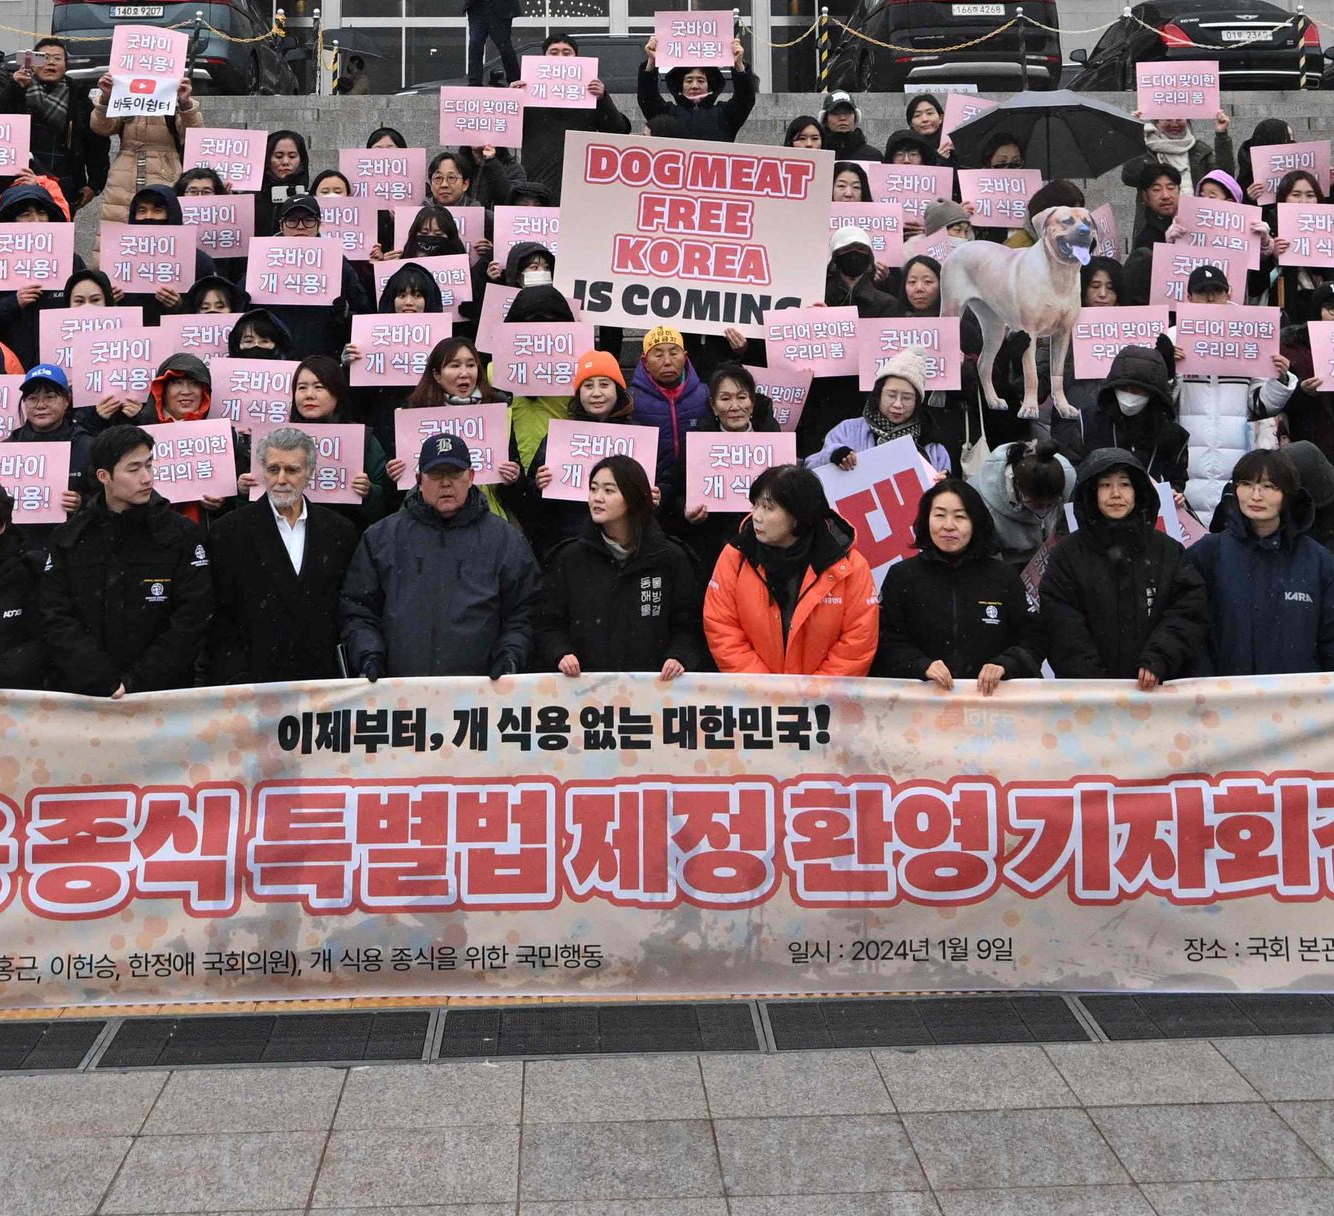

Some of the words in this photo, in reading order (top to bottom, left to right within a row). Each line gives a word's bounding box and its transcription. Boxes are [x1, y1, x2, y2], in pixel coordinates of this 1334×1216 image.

[140, 7, 162, 15] 9207
[979, 6, 1001, 14] 4268
[671, 20, 717, 36] 굿바이
[127, 34, 171, 52] 굿바이
[667, 42, 682, 58] 개
[687, 41, 722, 58] 식용!
[120, 55, 134, 71] 개
[139, 54, 174, 72] 식용!
[537, 65, 582, 81] 굿바이
[533, 84, 547, 99] 개
[552, 83, 585, 99] 식용!
[1141, 75, 1176, 88] 드디어
[1179, 74, 1214, 88] 맞이한
[113, 96, 170, 112] 바둑이쉼터
[444, 99, 480, 114] 드디어
[483, 100, 519, 115] 맞이한
[1153, 90, 1189, 105] 우리의
[1192, 90, 1203, 104] 봄
[455, 117, 492, 132] 우리의
[494, 117, 506, 132] 봄
[200, 138, 249, 157] 굿바이
[357, 158, 407, 177] 굿바이
[586, 144, 684, 188] DOG
[688, 152, 814, 199] MEAT
[1269, 151, 1315, 172] 굿바이
[353, 182, 368, 197] 개
[374, 182, 412, 200] 식용!
[886, 175, 936, 193] 굿바이
[978, 177, 1026, 195] 굿바이
[183, 205, 235, 225] 굿바이
[638, 192, 754, 238] FREE
[976, 200, 991, 217] 개
[859, 215, 899, 232] 맞이한
[1196, 209, 1244, 231] 굿바이
[120, 236, 175, 257] 굿바이
[201, 229, 240, 248] 식용!
[1292, 237, 1309, 257] 개
[267, 247, 323, 268] 굿바이
[612, 234, 770, 284] KOREA
[13, 259, 58, 279] 식용!
[114, 261, 131, 281] 개
[137, 261, 181, 283] 식용!
[259, 273, 277, 293] 개
[284, 274, 327, 294] 식용!
[1166, 280, 1184, 301] 개
[574, 280, 612, 313] IS
[370, 325, 430, 347] 굿바이
[769, 324, 811, 341] 드디어
[814, 321, 855, 341] 맞이한
[1077, 323, 1118, 340] 드디어
[1121, 321, 1164, 339] 맞이한
[1180, 321, 1224, 336] 드디어
[1228, 320, 1274, 340] 맞이한
[514, 334, 573, 356] 굿바이
[880, 330, 939, 351] 굿바이
[90, 340, 150, 362] 굿바이
[784, 344, 827, 360] 우리의
[830, 342, 844, 359] 봄
[1194, 342, 1239, 359] 우리의
[1243, 342, 1259, 360] 봄
[366, 353, 385, 374] 개
[507, 363, 526, 384] 개
[85, 371, 102, 392] 개
[221, 399, 240, 421] 개
[178, 436, 227, 459] 맞이한
[570, 434, 634, 459] 굿바이
[709, 444, 774, 470] 굿바이
[197, 460, 213, 479] 봄
[562, 465, 582, 487] 개
[702, 475, 723, 499] 개
[1284, 590, 1314, 602] KARA
[277, 709, 443, 755] 이제부터,
[452, 707, 489, 751] 개
[497, 705, 572, 751] 식용
[579, 705, 653, 750] 없는
[663, 704, 832, 752] 대한민국!
[26, 790, 239, 914] 종식
[247, 784, 555, 908] 특별법
[563, 782, 775, 903] 제정
[783, 782, 996, 901] 환영
[788, 940, 831, 964] 일시
[852, 938, 930, 962] 2024년
[938, 937, 969, 962] 1월
[977, 937, 1013, 961] 9일
[1184, 937, 1228, 961] 장소
[1247, 936, 1290, 963] 국회
[50, 952, 121, 981] 이헌승,
[129, 950, 195, 977] 한정애
[202, 949, 302, 976] 국회의원),
[310, 948, 332, 974] 개
[340, 947, 383, 972] 식용
[390, 945, 458, 971] 종식을
[464, 944, 508, 970] 위한
[515, 943, 604, 970] 국민행동
